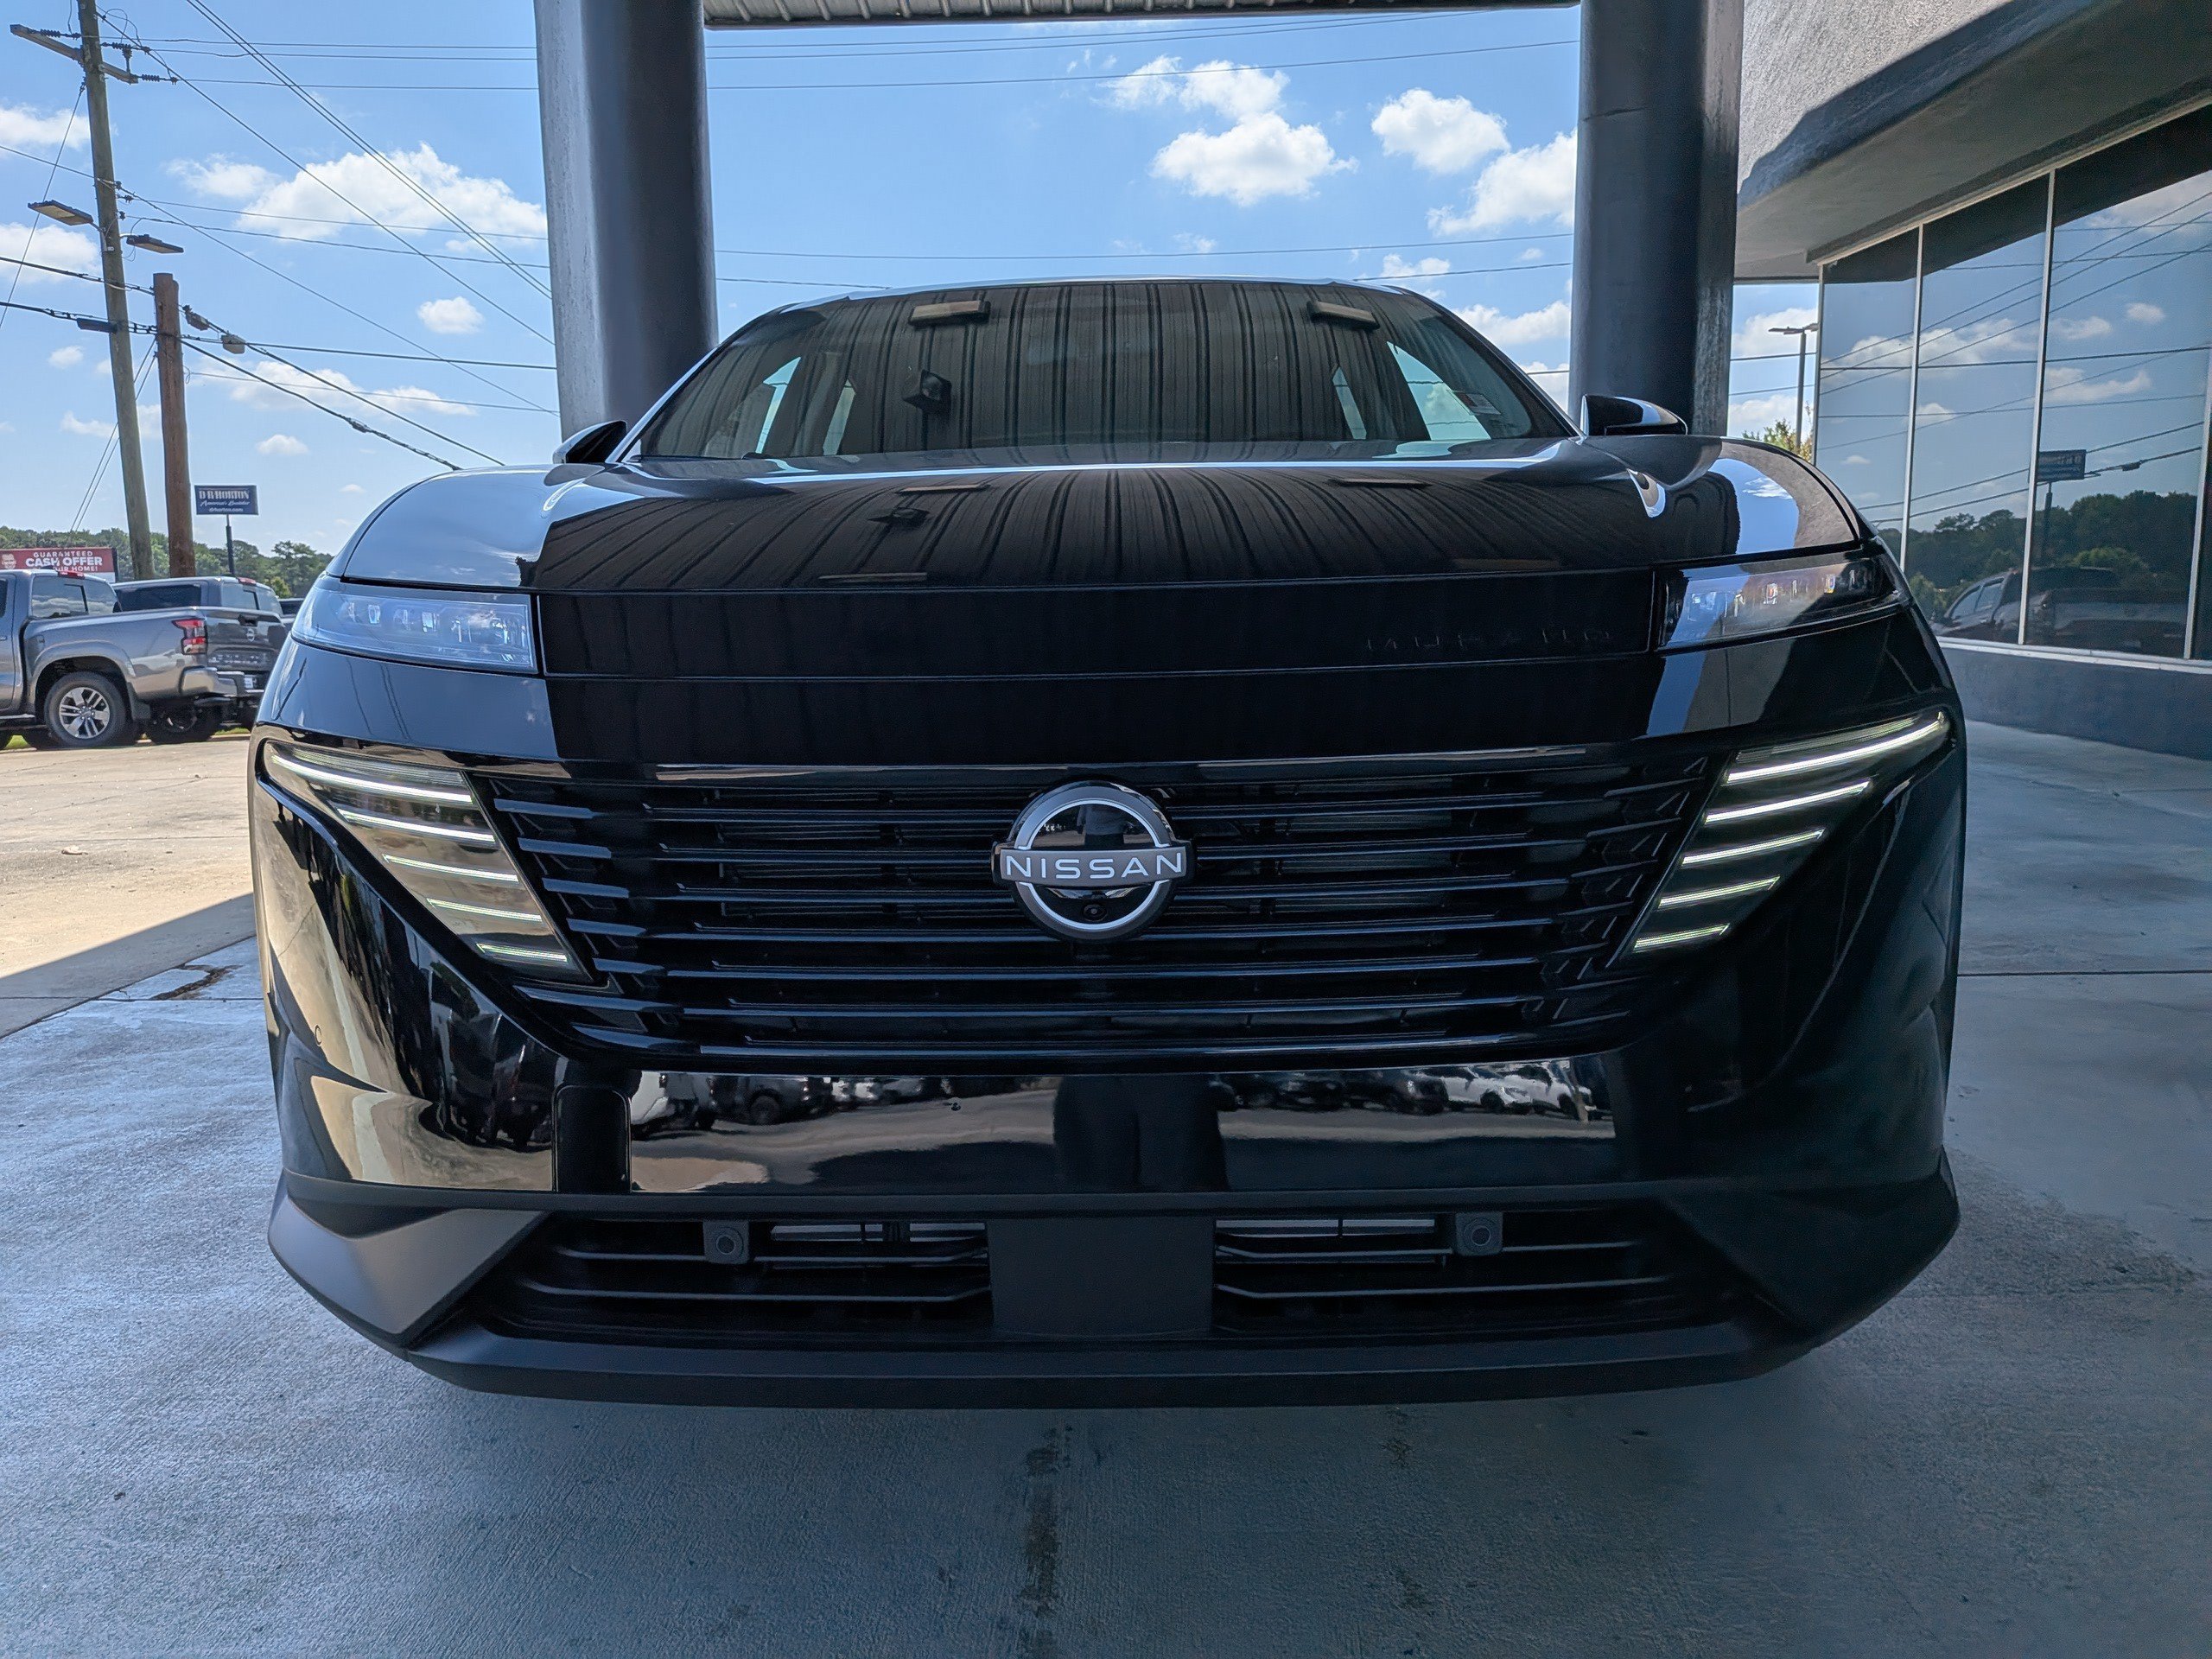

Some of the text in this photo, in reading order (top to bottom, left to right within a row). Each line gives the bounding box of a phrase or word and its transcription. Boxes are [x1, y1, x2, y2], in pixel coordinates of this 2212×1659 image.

[25, 556, 103, 567] CASH OFFER
[1006, 852, 1181, 880] NISSAN
